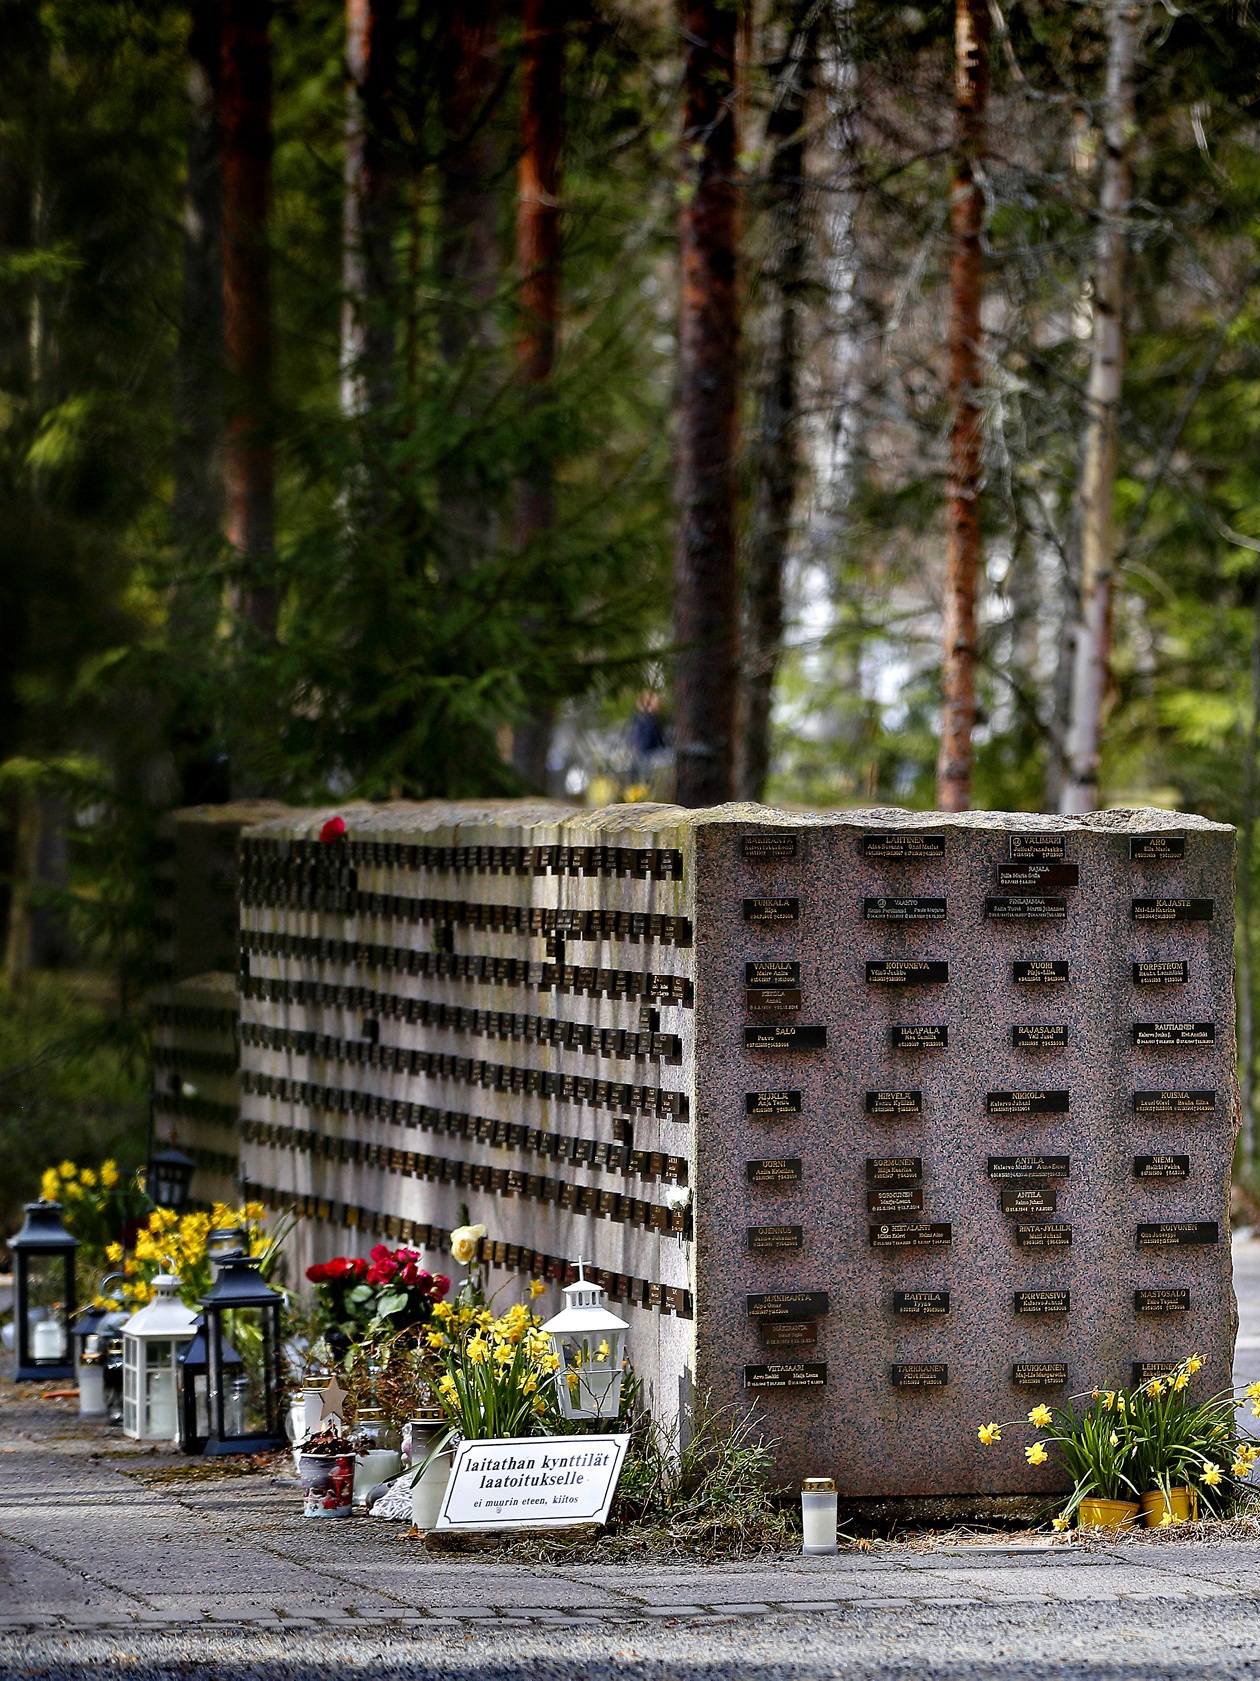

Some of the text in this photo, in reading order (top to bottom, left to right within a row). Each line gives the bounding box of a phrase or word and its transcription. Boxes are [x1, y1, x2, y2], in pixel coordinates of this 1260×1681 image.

[886, 836, 924, 844] LAHTINEN
[1149, 838, 1166, 846] ARO
[775, 1027, 796, 1035] SALO
[901, 1027, 940, 1035] HAAPALA
[1018, 1026, 1064, 1034] RAJASAARI
[1161, 1091, 1190, 1099] KUISMA
[873, 1159, 915, 1167] SORMUNEN
[1152, 1156, 1174, 1164] NIEMI
[1160, 1224, 1198, 1232] KOIVUNEN
[904, 1293, 941, 1301] RAITTILA
[1019, 1292, 1066, 1300] JÄRVENSIVU
[1140, 1290, 1186, 1298] MASTOSALO
[767, 1364, 805, 1372] VIITASAARI
[1017, 1364, 1065, 1372] LUUKKAINEN
[464, 1453, 610, 1472] laitathan kynttilät
[479, 1471, 584, 1489] laatoitukselle
[473, 1495, 579, 1508] ei muurin eteen, kiitos
